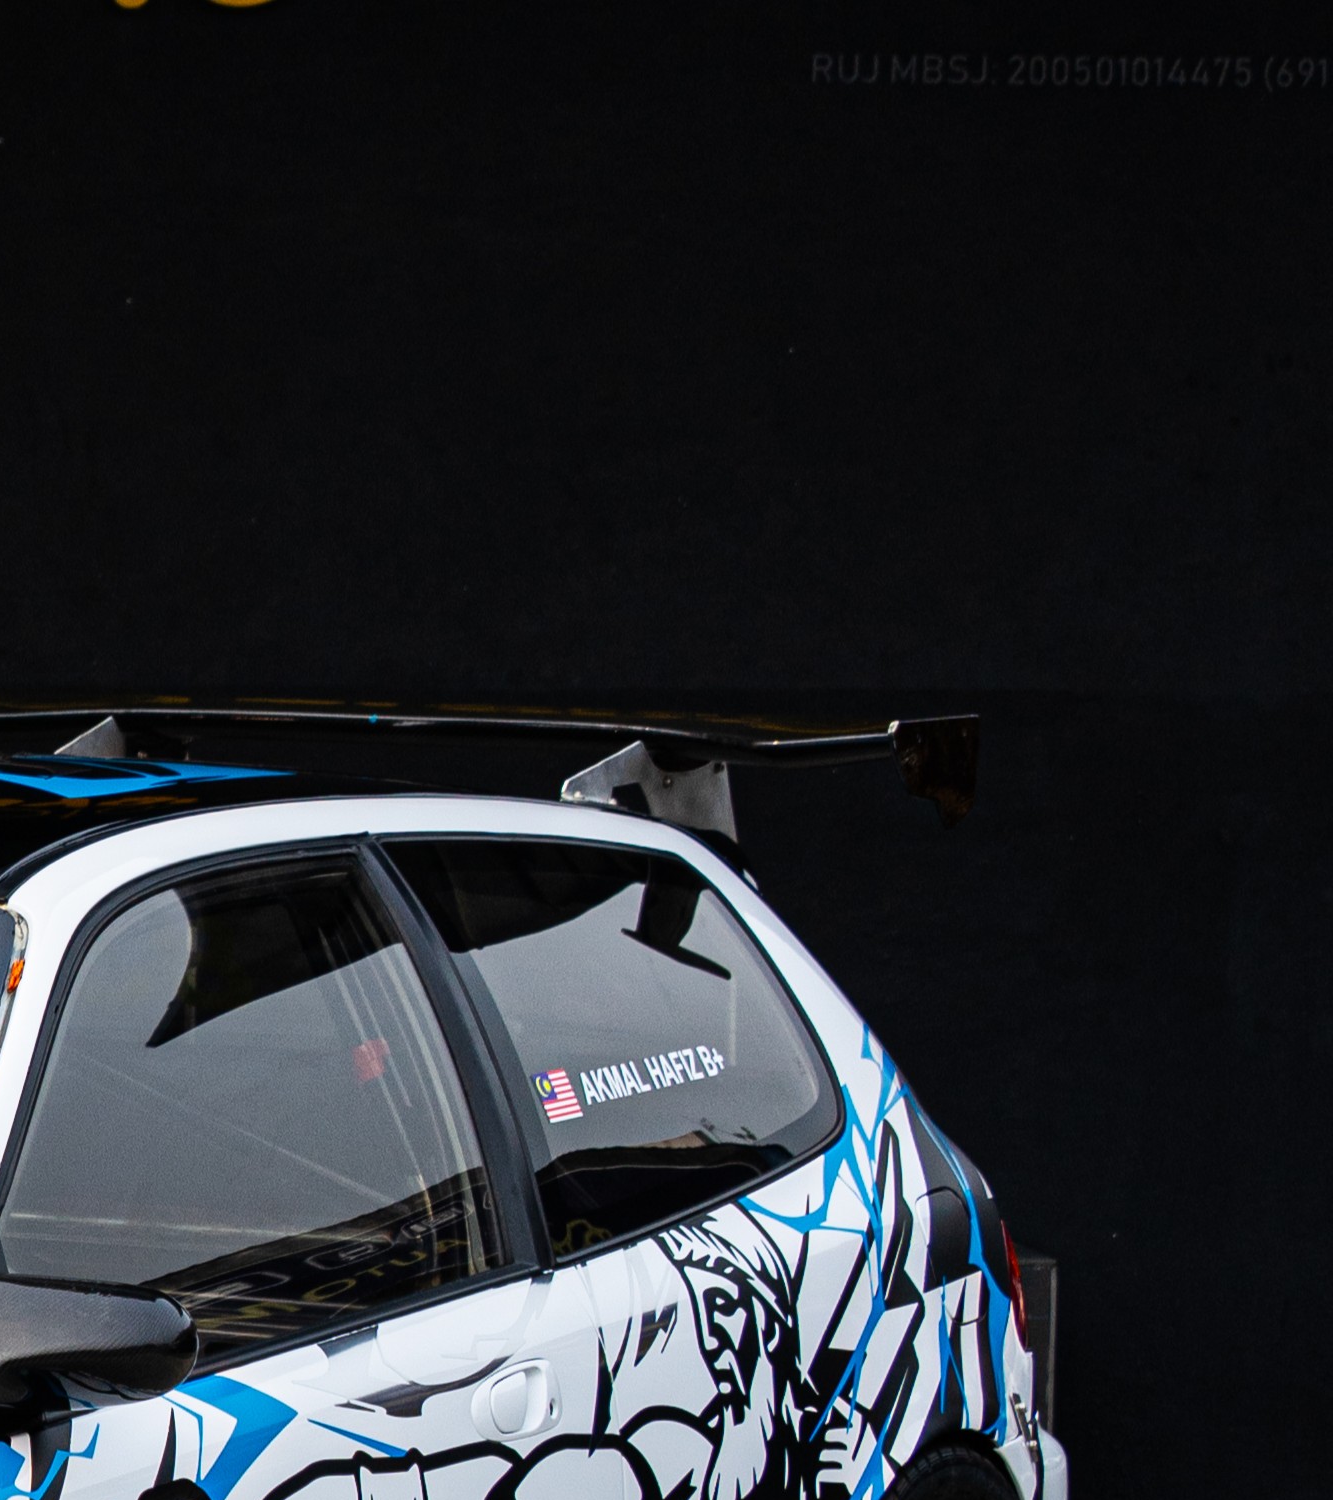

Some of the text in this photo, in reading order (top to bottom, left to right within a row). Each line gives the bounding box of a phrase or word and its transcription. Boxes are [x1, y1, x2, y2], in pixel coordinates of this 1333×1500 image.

[810, 53, 880, 86] RUJ
[1007, 54, 1253, 88] 200501014475
[579, 1045, 725, 1106] AKMAL HAFIZ B+
